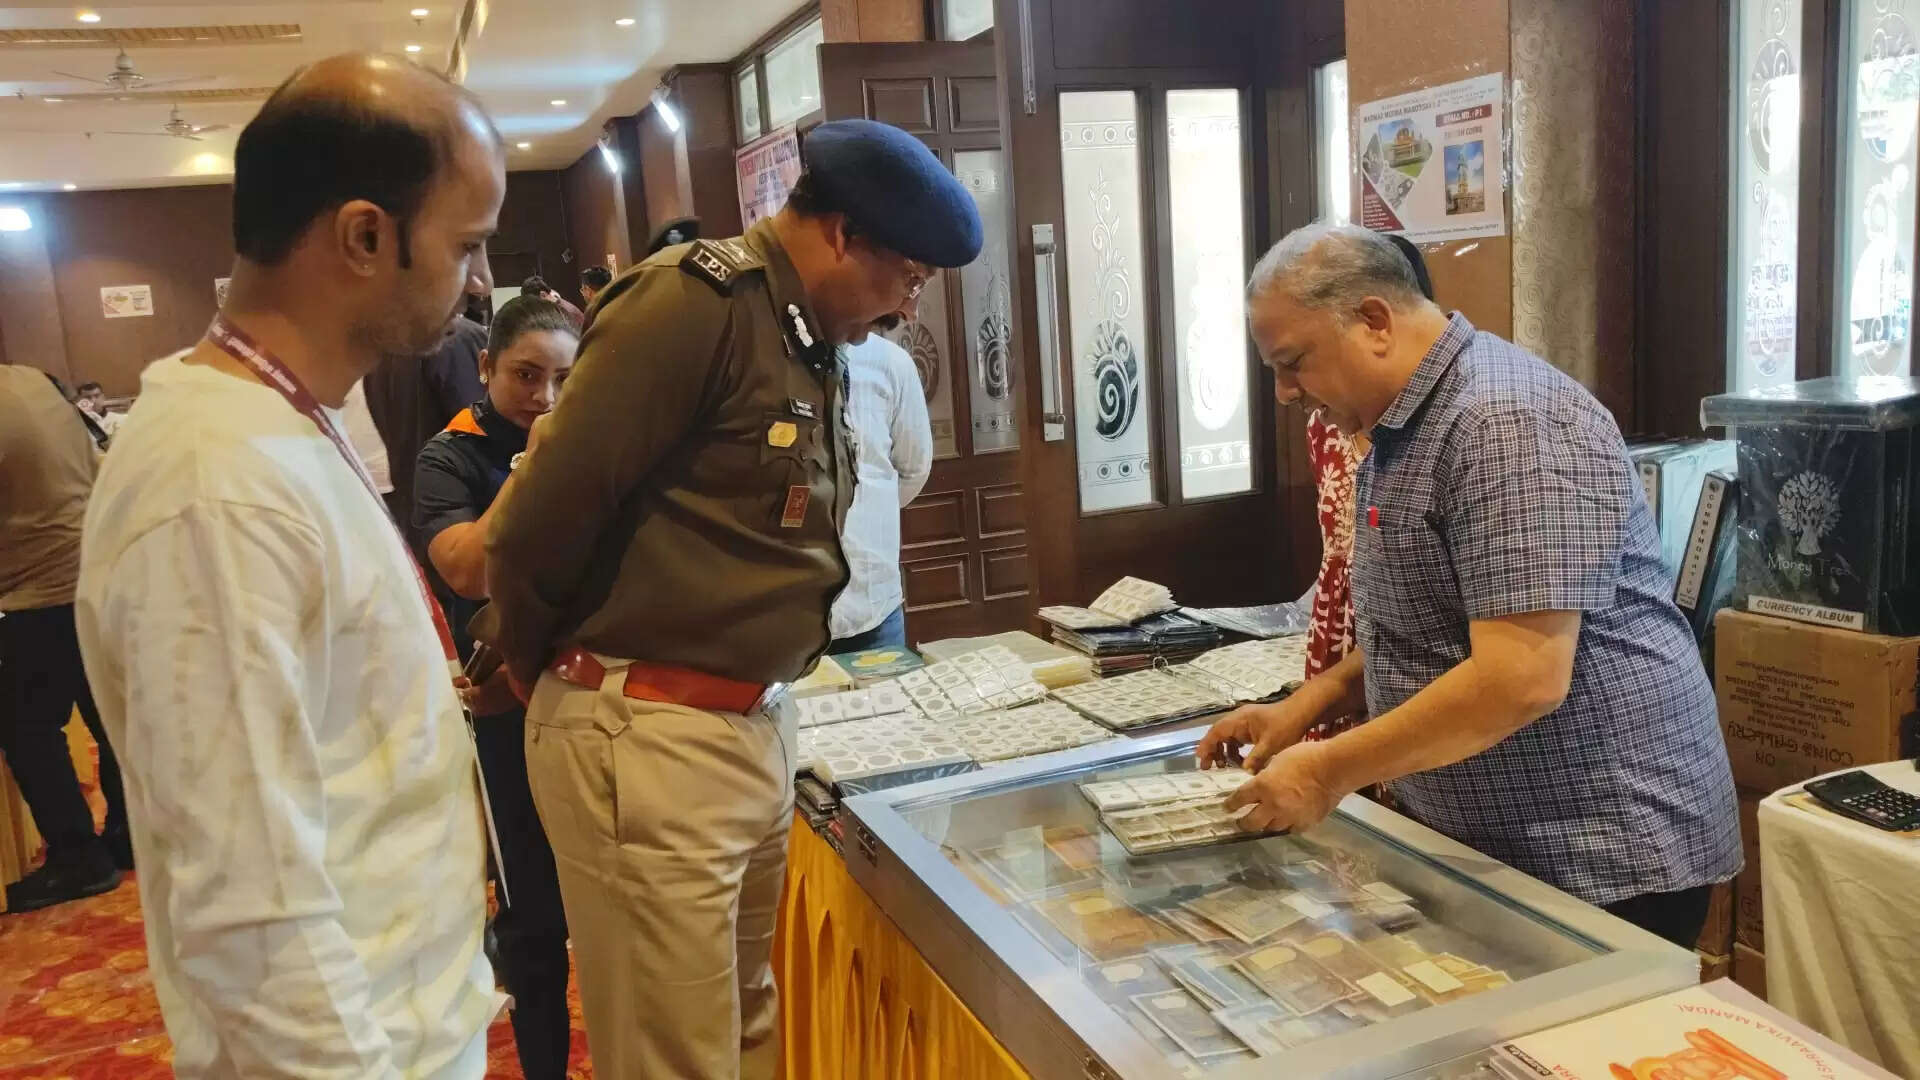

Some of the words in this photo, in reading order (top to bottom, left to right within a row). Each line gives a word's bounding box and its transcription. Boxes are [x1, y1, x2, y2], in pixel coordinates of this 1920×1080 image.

[1768, 552, 1812, 576] Money
[1757, 600, 1813, 617] CURRENCY
[1816, 610, 1854, 624] ALBUM
